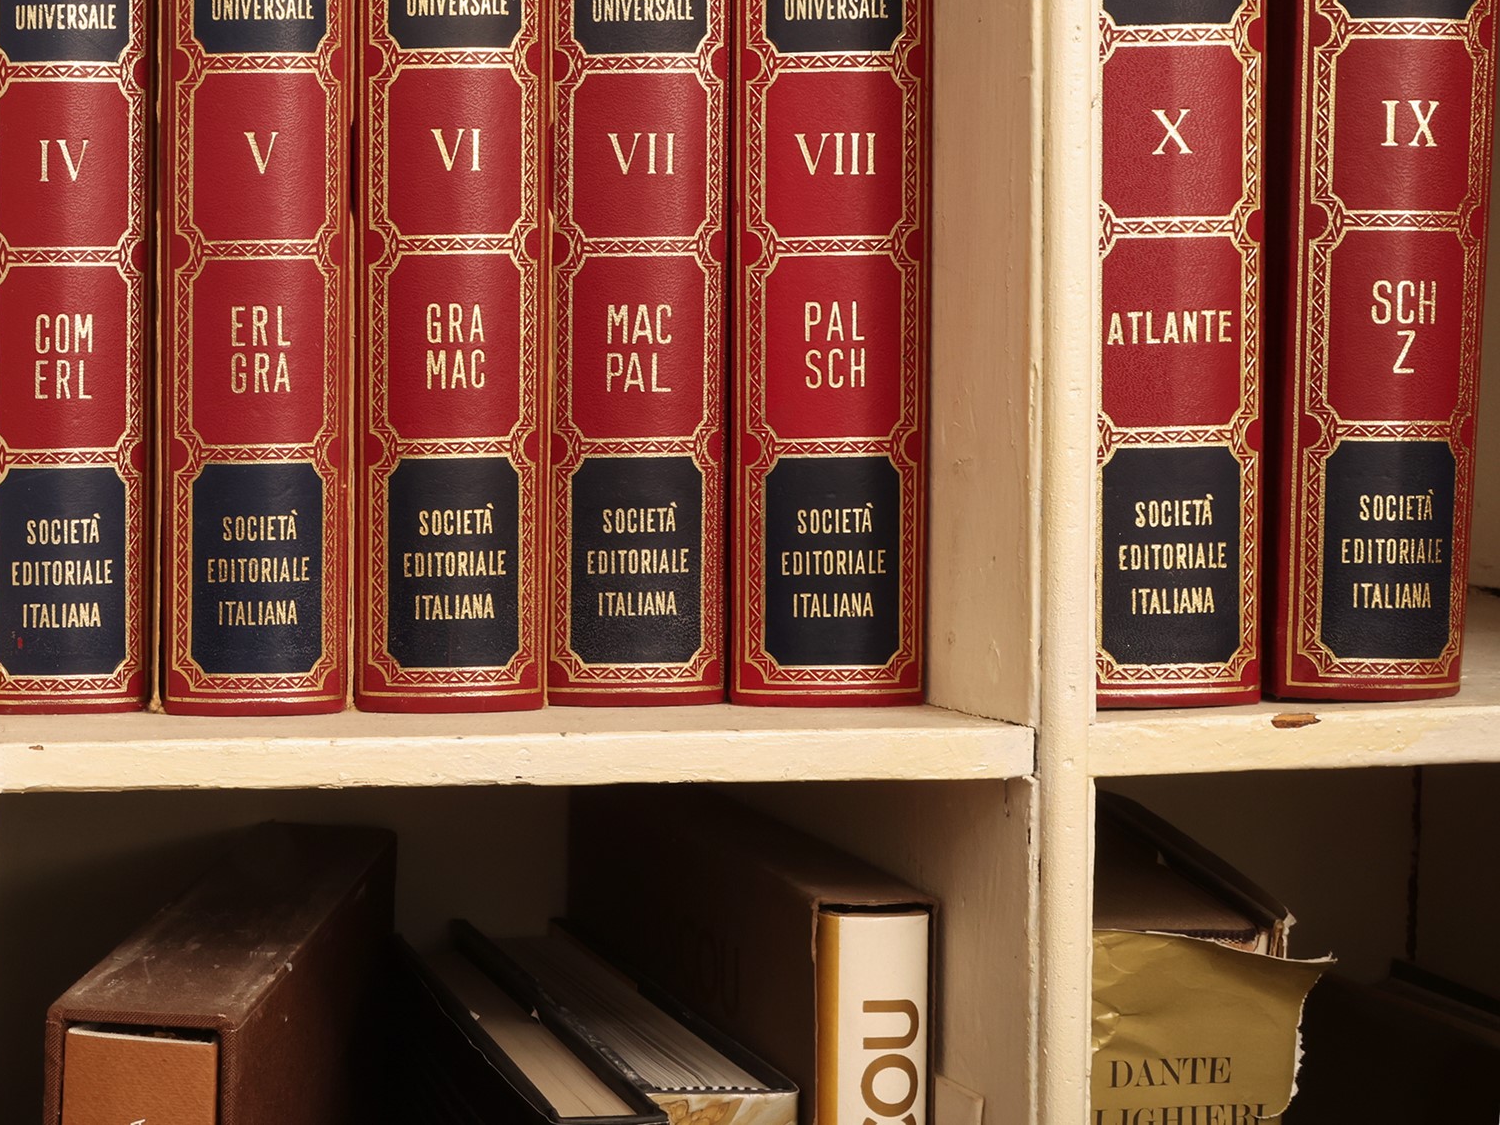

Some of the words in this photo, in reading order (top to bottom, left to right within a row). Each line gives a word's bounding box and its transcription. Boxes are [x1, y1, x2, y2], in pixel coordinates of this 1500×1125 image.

[16, 4, 116, 30] UNIVERSALE
[1152, 109, 1193, 155] X
[1381, 100, 1439, 147] IX
[40, 140, 89, 181] IV
[244, 132, 279, 174] V
[431, 129, 481, 171] VI
[608, 133, 674, 174] VII
[795, 133, 875, 175] VIII
[1372, 280, 1436, 324] SCH
[36, 314, 93, 353] COM
[232, 306, 291, 347] ERL
[427, 303, 484, 343] GRA
[608, 304, 672, 344] MAC
[805, 301, 864, 341] PAL
[1107, 310, 1231, 345] ATLANTE
[1393, 330, 1415, 373] Z
[35, 360, 92, 399] ERL
[232, 352, 290, 393] GRA
[427, 349, 485, 389] MAC
[607, 352, 671, 392] PAL
[806, 348, 865, 388] SCH
[420, 503, 493, 535] SOCIETÀ
[603, 502, 677, 533] SOCIETÀ
[798, 503, 873, 534] SOCIETÀ
[1135, 494, 1213, 527] SOCIETÀ
[1360, 490, 1433, 521] SOCIETÀ
[27, 513, 100, 544] SOCIETÀ
[223, 509, 297, 541] SOCIETÀ
[404, 550, 506, 577] EDITORIALE
[588, 549, 689, 574] EDITORIALE
[782, 550, 886, 575] EDITORIALE
[1119, 543, 1227, 570] EDITORIALE
[1341, 538, 1443, 565] EDITORIALE
[12, 560, 112, 585] EDITORIALE
[208, 557, 309, 582] EDITORIALE
[416, 594, 494, 620] ITALIANA
[599, 591, 677, 616] ITALIANA
[794, 593, 873, 617] ITALIANA
[1132, 587, 1214, 614] ITALIANA
[1354, 583, 1431, 608] ITALIANA
[23, 603, 101, 628] ITALIANA
[219, 600, 297, 625] ITALIANA
[1109, 1057, 1231, 1088] DANTE
